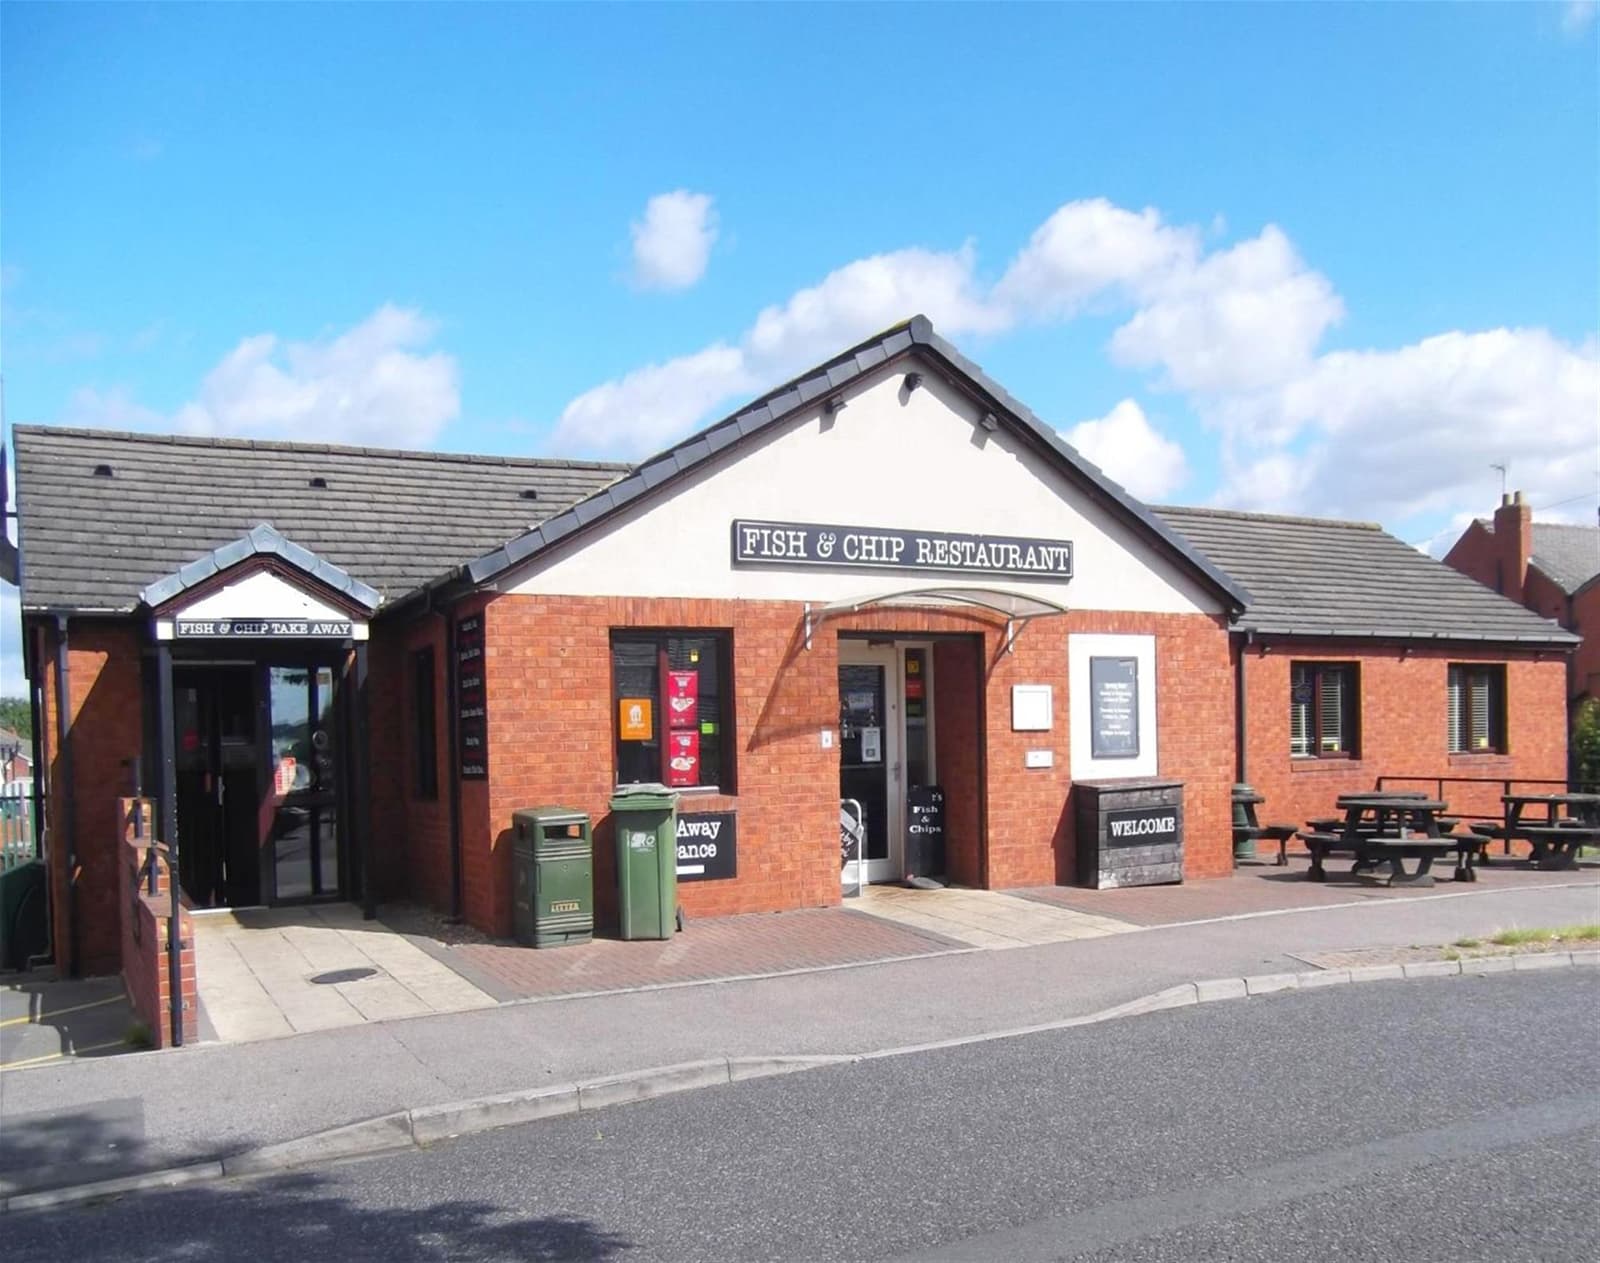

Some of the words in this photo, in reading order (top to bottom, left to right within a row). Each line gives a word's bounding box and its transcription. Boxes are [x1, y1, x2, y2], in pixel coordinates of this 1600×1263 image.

[743, 528, 807, 557] FISH
[817, 532, 837, 558] &
[843, 534, 905, 562] CHIP
[915, 538, 1069, 571] RESTAURANT
[180, 623, 215, 634] FISH
[219, 623, 231, 634] &
[234, 623, 269, 634] CHIP
[271, 623, 308, 634] TAKE
[312, 623, 350, 634] AWAY
[912, 805, 938, 814] Fish
[921, 815, 930, 823] &
[676, 819, 721, 840] Away
[909, 824, 942, 834] Chips
[1110, 816, 1175, 837] WELCOME
[676, 843, 717, 860] ance
